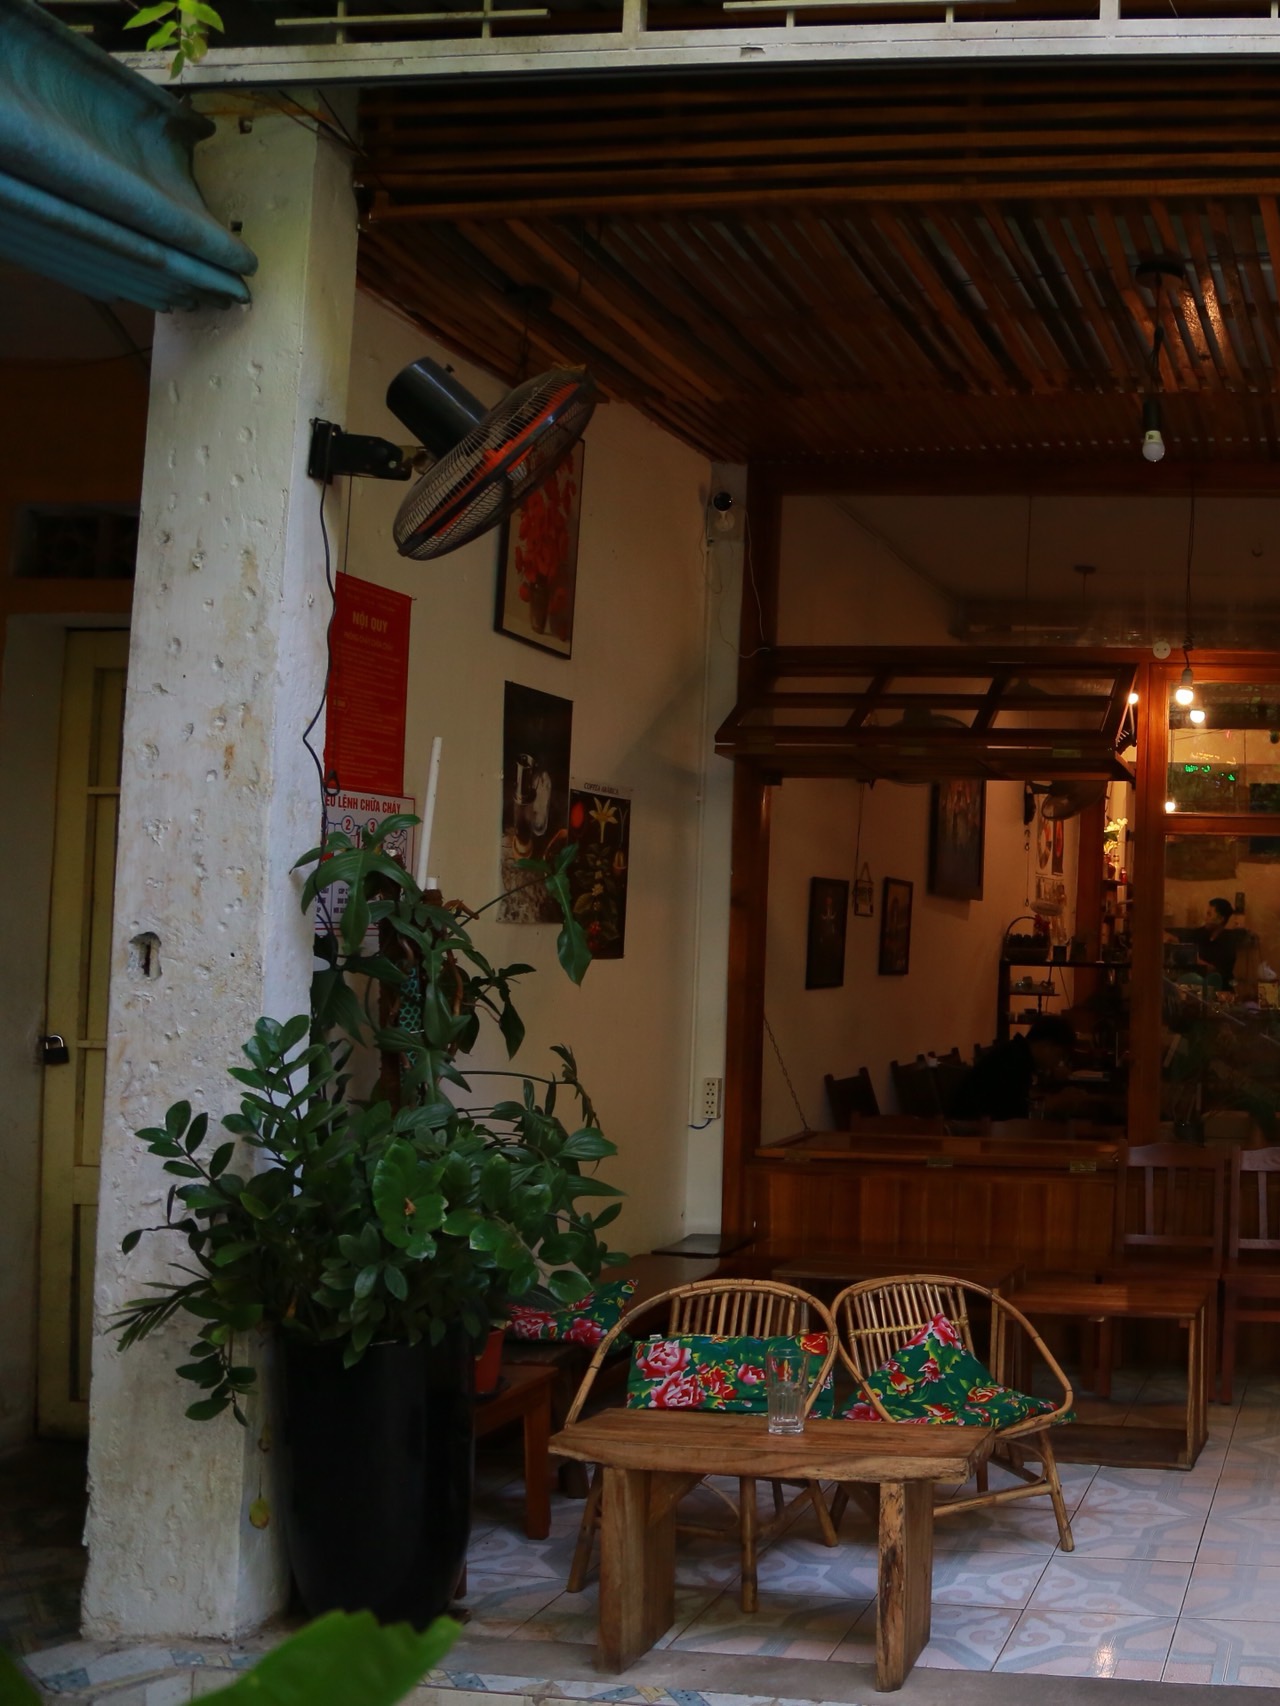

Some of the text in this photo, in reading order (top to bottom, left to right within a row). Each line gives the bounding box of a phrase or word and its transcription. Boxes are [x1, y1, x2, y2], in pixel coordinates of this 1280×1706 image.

[352, 610, 389, 634] NỘI QUY
[338, 794, 358, 811] LỆNH
[360, 797, 381, 813] CHỮA
[382, 800, 401, 815] CHÁY
[345, 818, 351, 831] 2
[370, 821, 376, 833] 3
